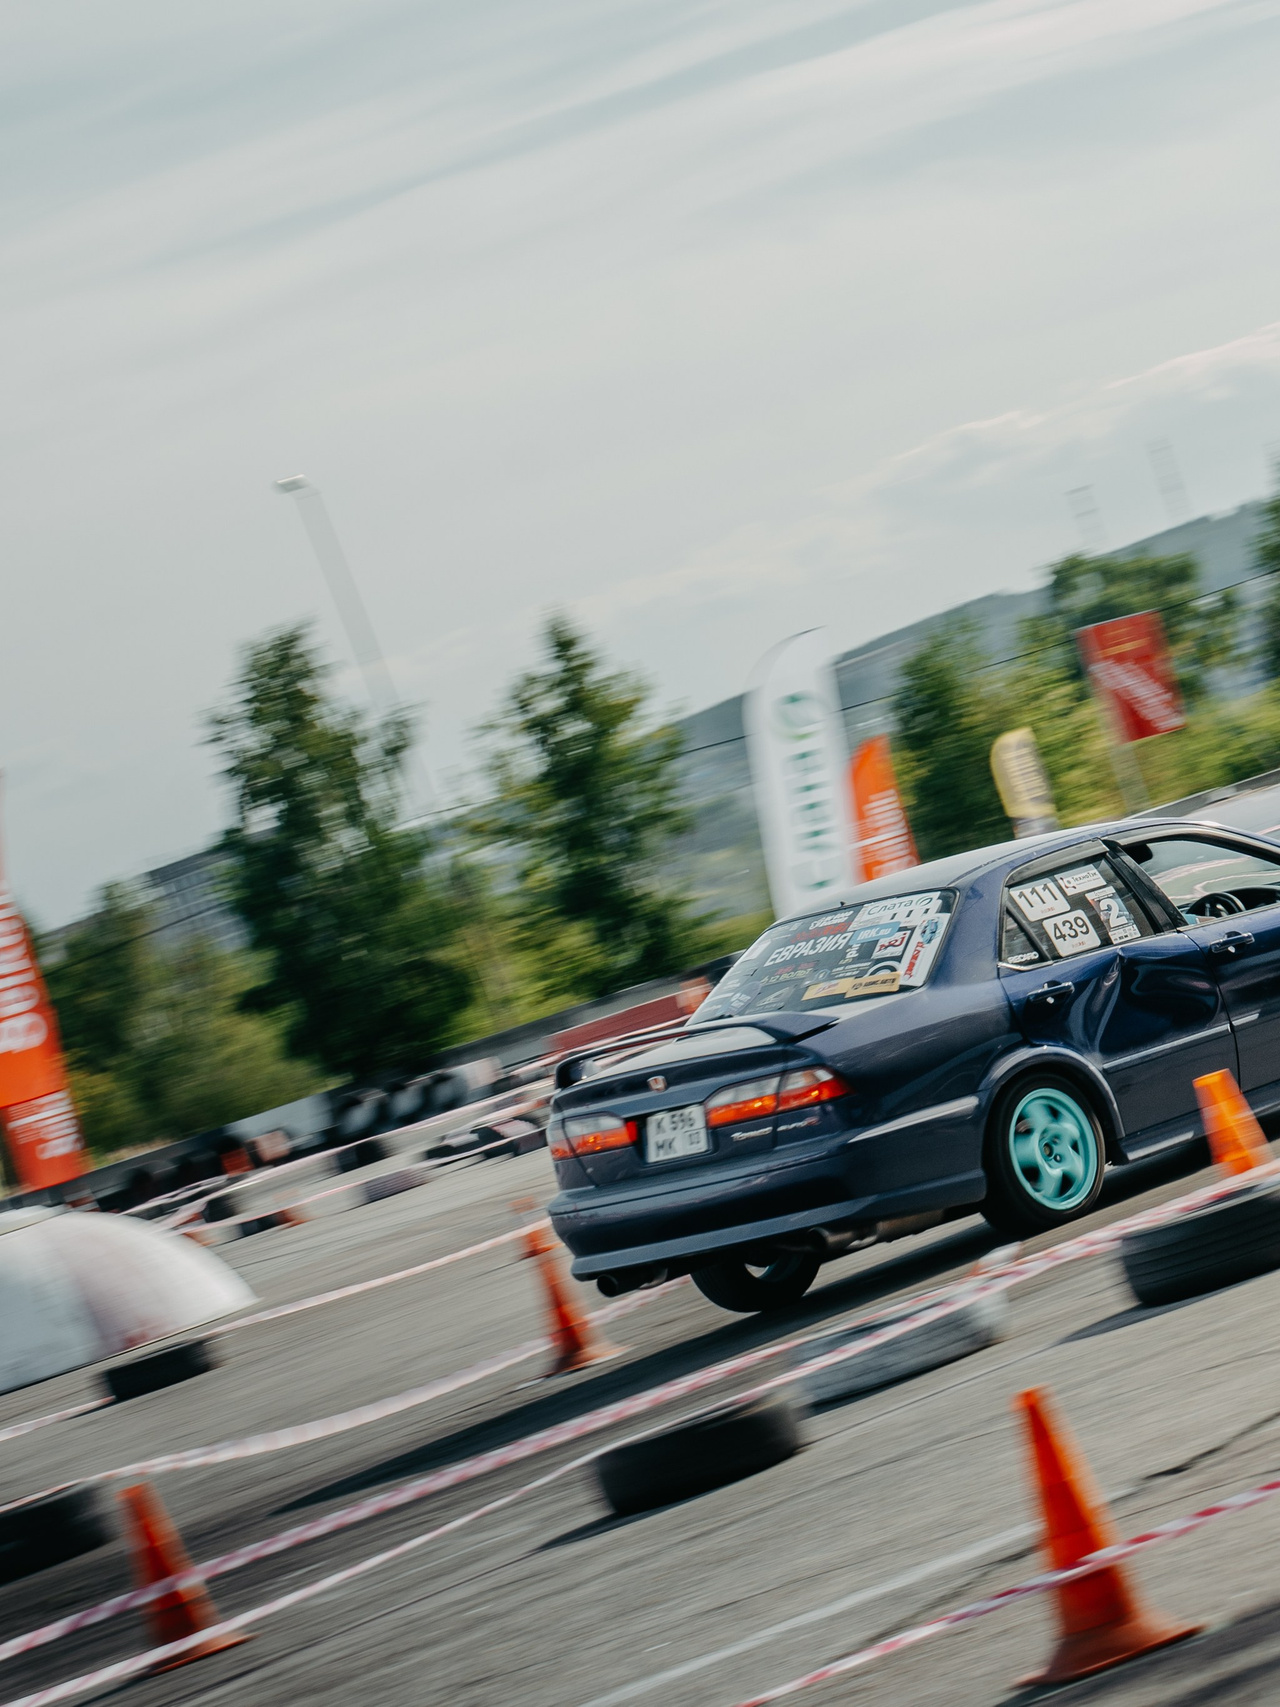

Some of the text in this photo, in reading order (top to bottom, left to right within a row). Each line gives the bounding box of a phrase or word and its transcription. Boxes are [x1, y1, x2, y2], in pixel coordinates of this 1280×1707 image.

[868, 900, 912, 915] Слата
[1018, 884, 1058, 908] 111
[1100, 898, 1128, 928] 2
[1054, 917, 1090, 941] 439
[764, 932, 853, 967] ЕВРАЗИЯ
